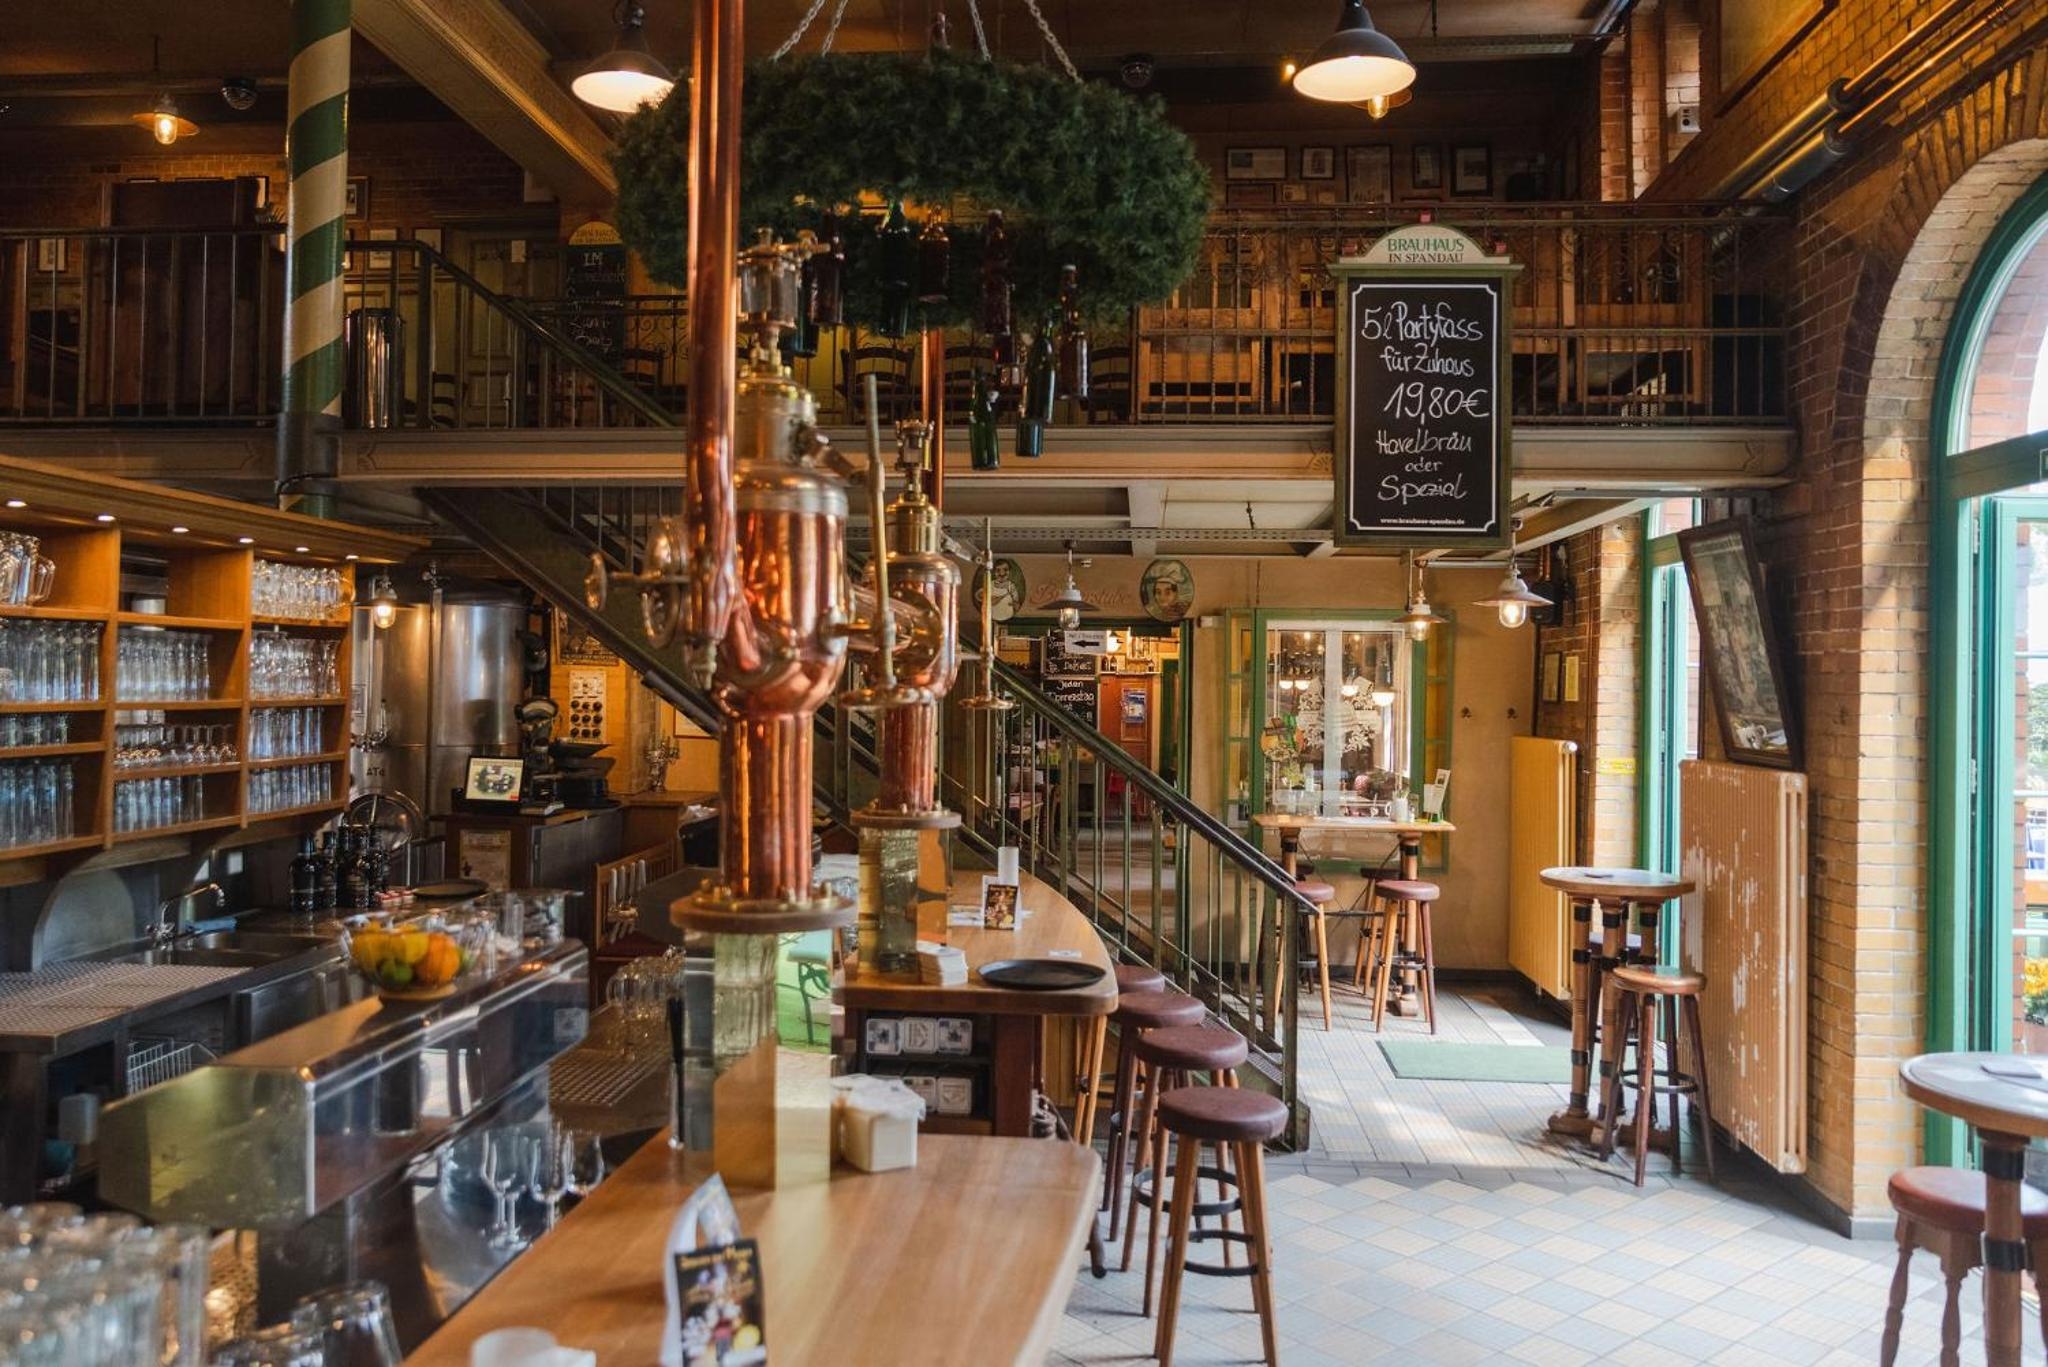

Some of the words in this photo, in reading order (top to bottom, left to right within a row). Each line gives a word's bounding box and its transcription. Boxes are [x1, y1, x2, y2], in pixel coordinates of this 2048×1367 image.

[1387, 238, 1465, 252] BRAUHAUS
[1388, 253, 1401, 263] IN
[1404, 253, 1464, 263] SPANDAU
[1390, 301, 1484, 347] Partyfass
[1379, 345, 1412, 372] für
[1413, 342, 1475, 377] Zuhaus
[1383, 382, 1490, 424] 19,80€
[1376, 428, 1472, 455] Havelbräu
[1404, 456, 1443, 472] oder
[1377, 473, 1468, 505] Spezial
